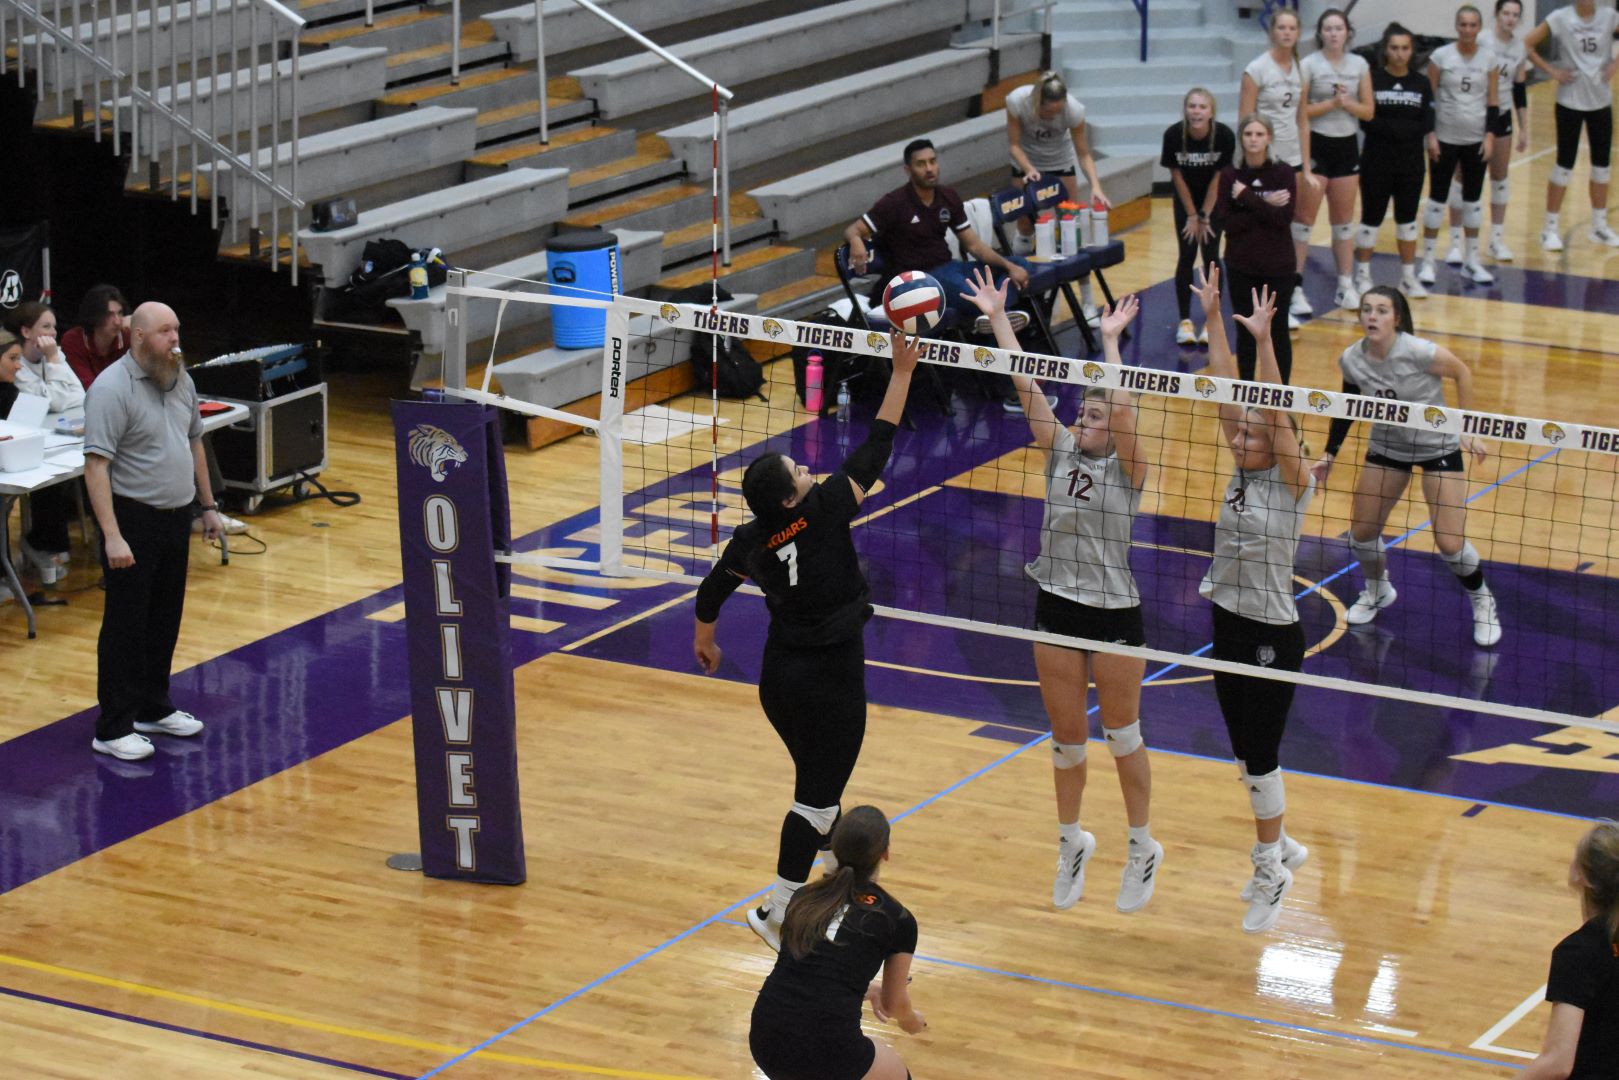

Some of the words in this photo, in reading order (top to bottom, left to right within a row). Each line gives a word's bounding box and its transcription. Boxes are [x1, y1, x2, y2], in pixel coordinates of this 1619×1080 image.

[1581, 37, 1598, 53] 15
[1460, 77, 1471, 93] 5
[1282, 92, 1293, 108] 2
[609, 251, 619, 296] POWER
[693, 311, 749, 335] TIGERS
[796, 325, 853, 349] TIGERS
[905, 340, 961, 364] GERS
[1009, 354, 1070, 379] TIGERS
[1119, 369, 1180, 394] TIGERS
[1231, 383, 1294, 408] TIGERS
[1345, 398, 1409, 424] TIGERS
[1462, 414, 1527, 440] TIGERS
[1067, 468, 1093, 502] 12
[775, 541, 799, 587] 7
[423, 494, 480, 871] OLIVET
